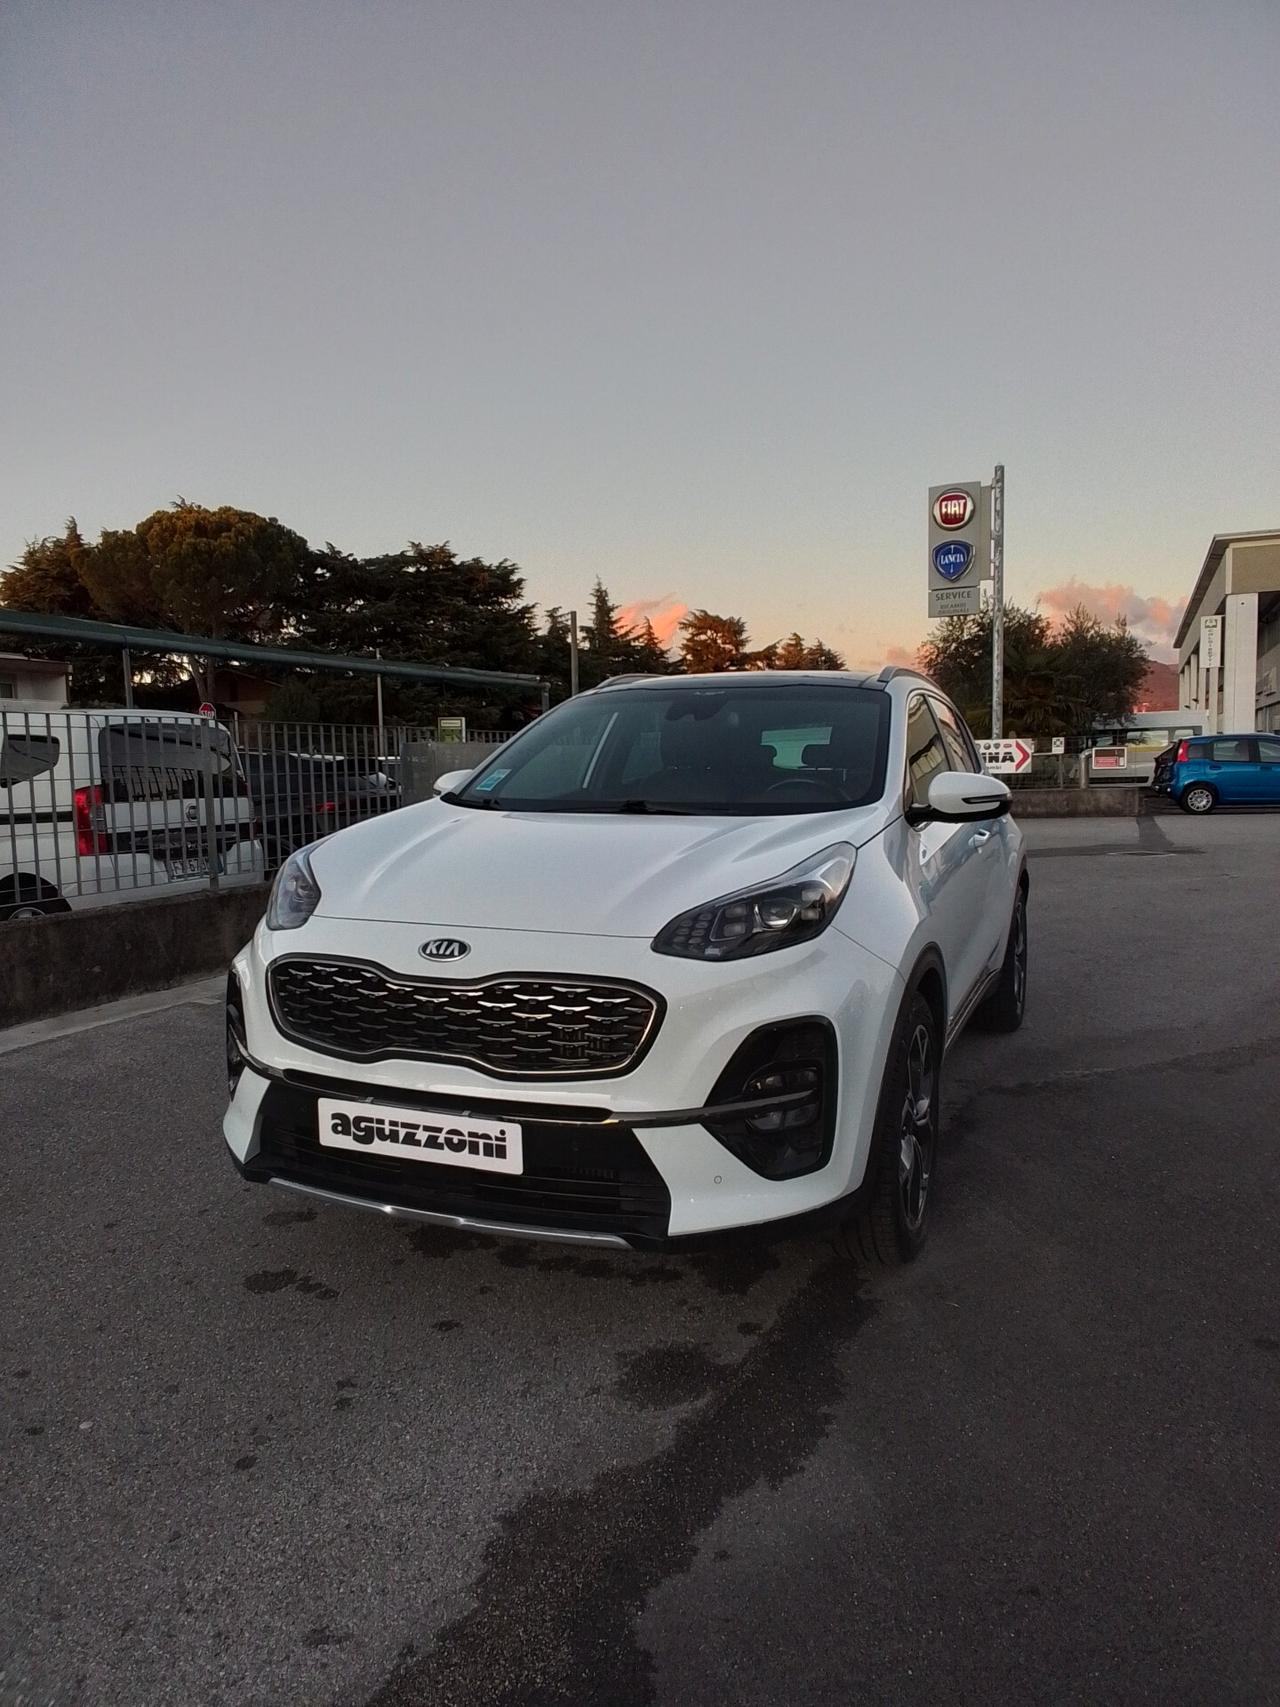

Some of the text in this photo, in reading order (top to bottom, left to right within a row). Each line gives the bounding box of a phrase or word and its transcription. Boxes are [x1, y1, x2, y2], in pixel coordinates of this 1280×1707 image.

[942, 500, 966, 514] FIAT
[940, 553, 964, 565] LANCIA
[935, 590, 972, 601] SERVICE
[425, 940, 460, 956] KIA
[331, 1112, 507, 1160] aguzzoni
